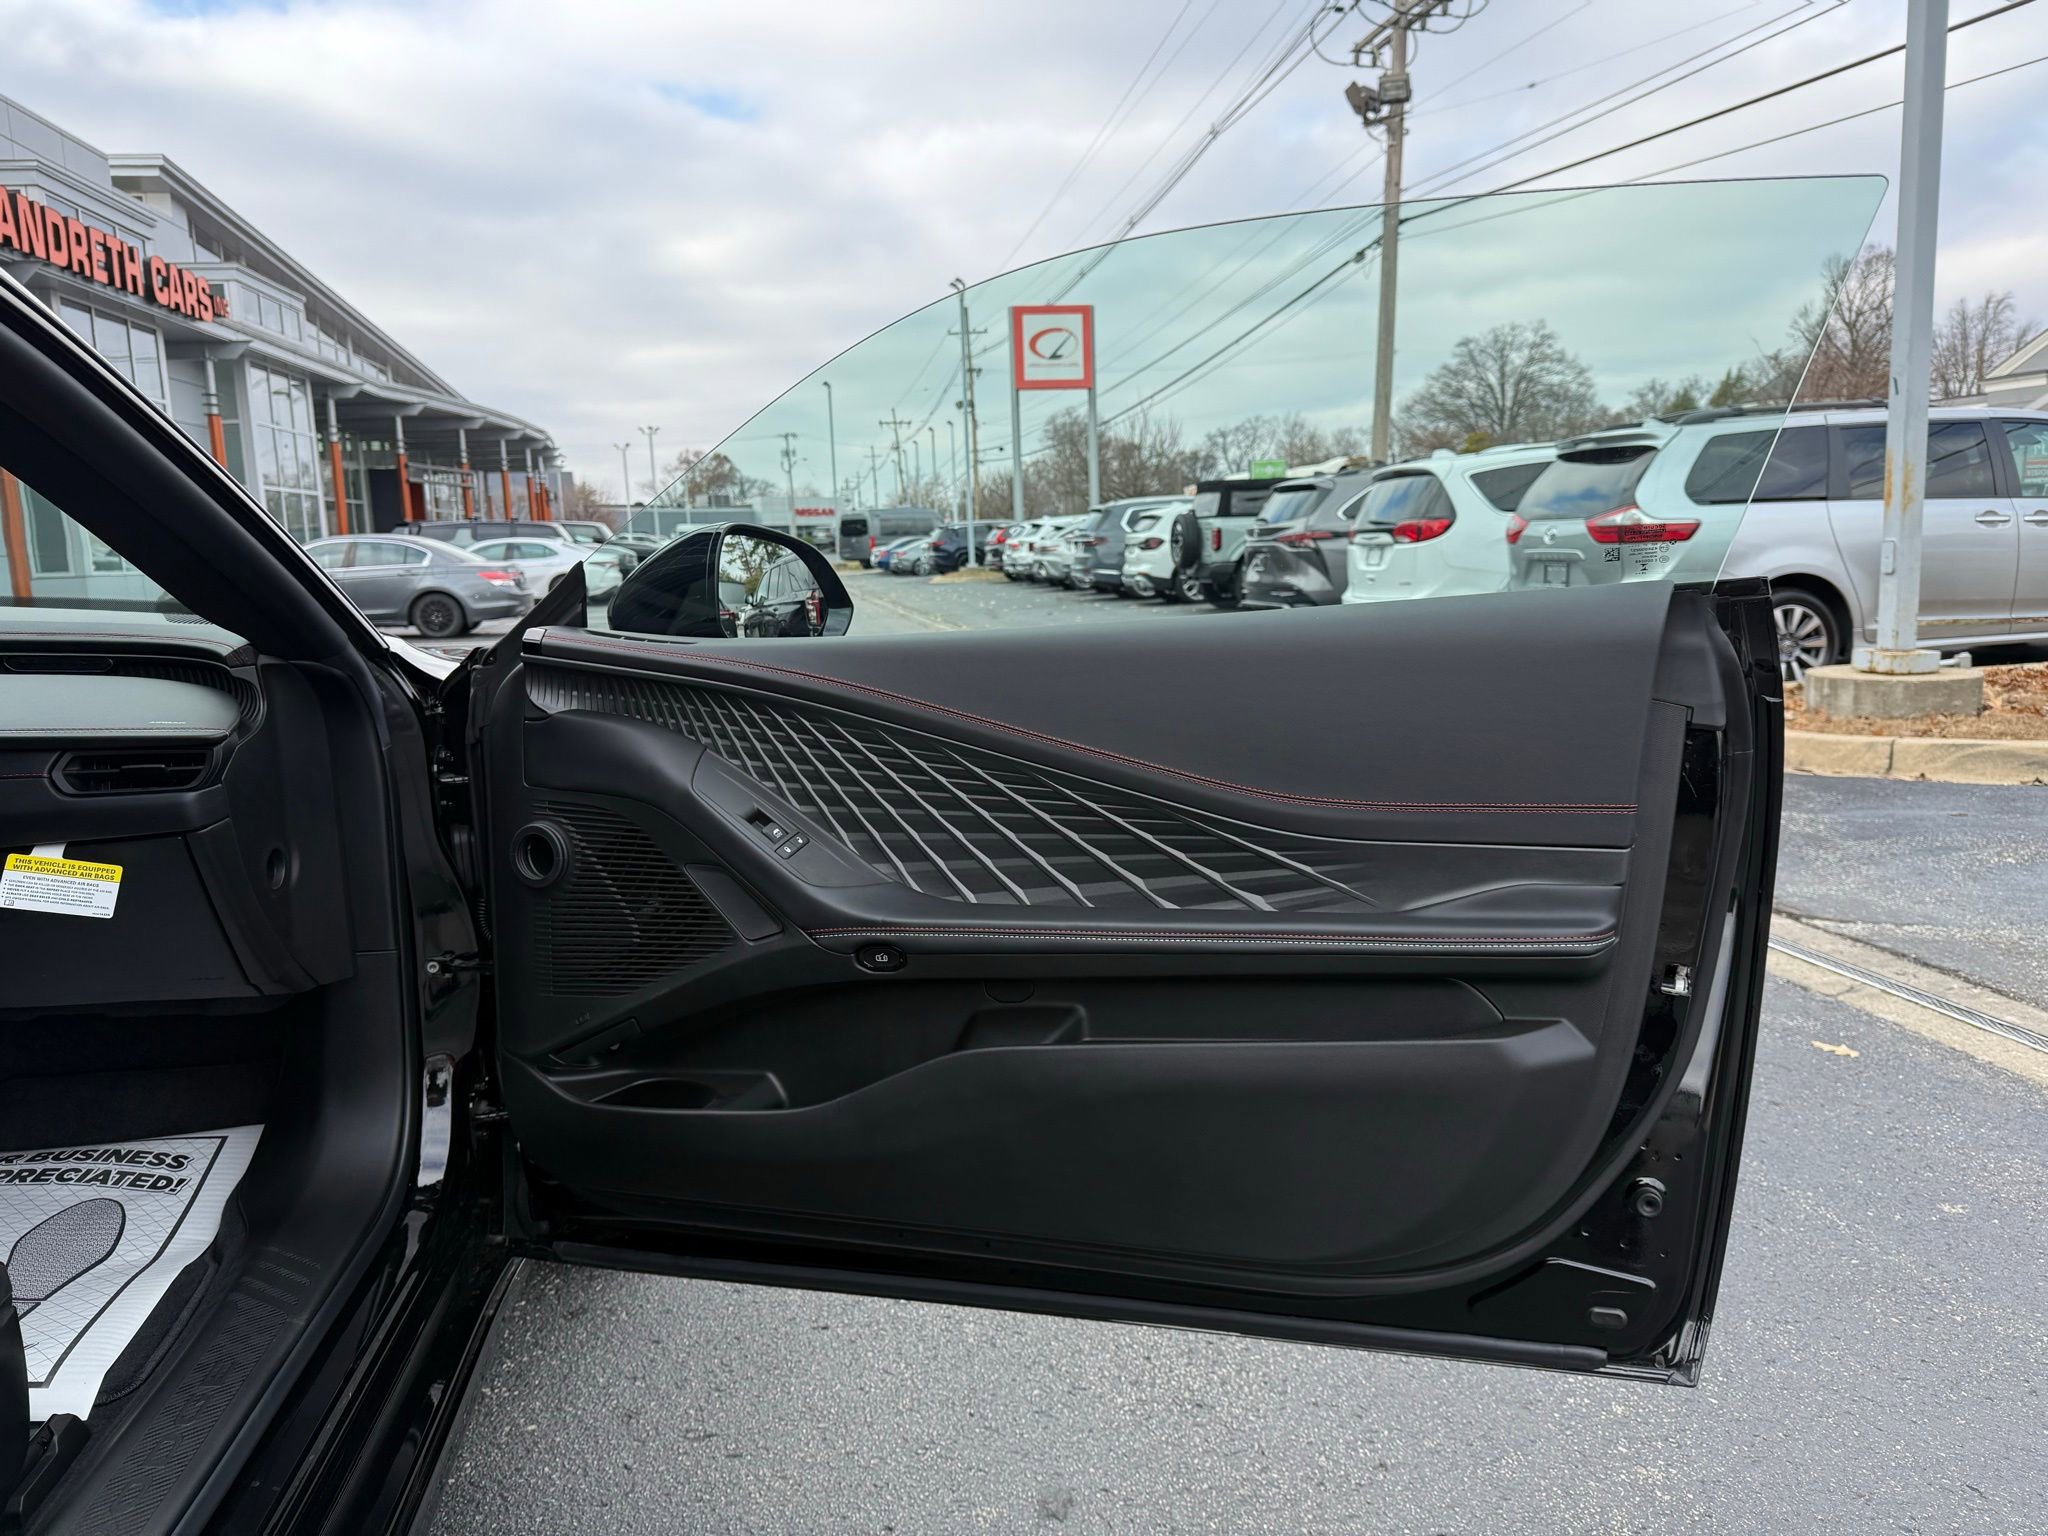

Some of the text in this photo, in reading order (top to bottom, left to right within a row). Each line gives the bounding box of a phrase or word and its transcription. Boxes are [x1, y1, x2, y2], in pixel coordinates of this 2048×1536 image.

[150, 255, 213, 322] CARS
[13, 864, 33, 872] WITH
[34, 866, 78, 877] ADVANCED
[94, 873, 115, 881] BAGS
[34, 860, 67, 869] VEHICLE
[77, 865, 116, 875] EQUIPPED
[50, 877, 77, 886] ADVANCED
[24, 1148, 191, 1170] BUSINESS
